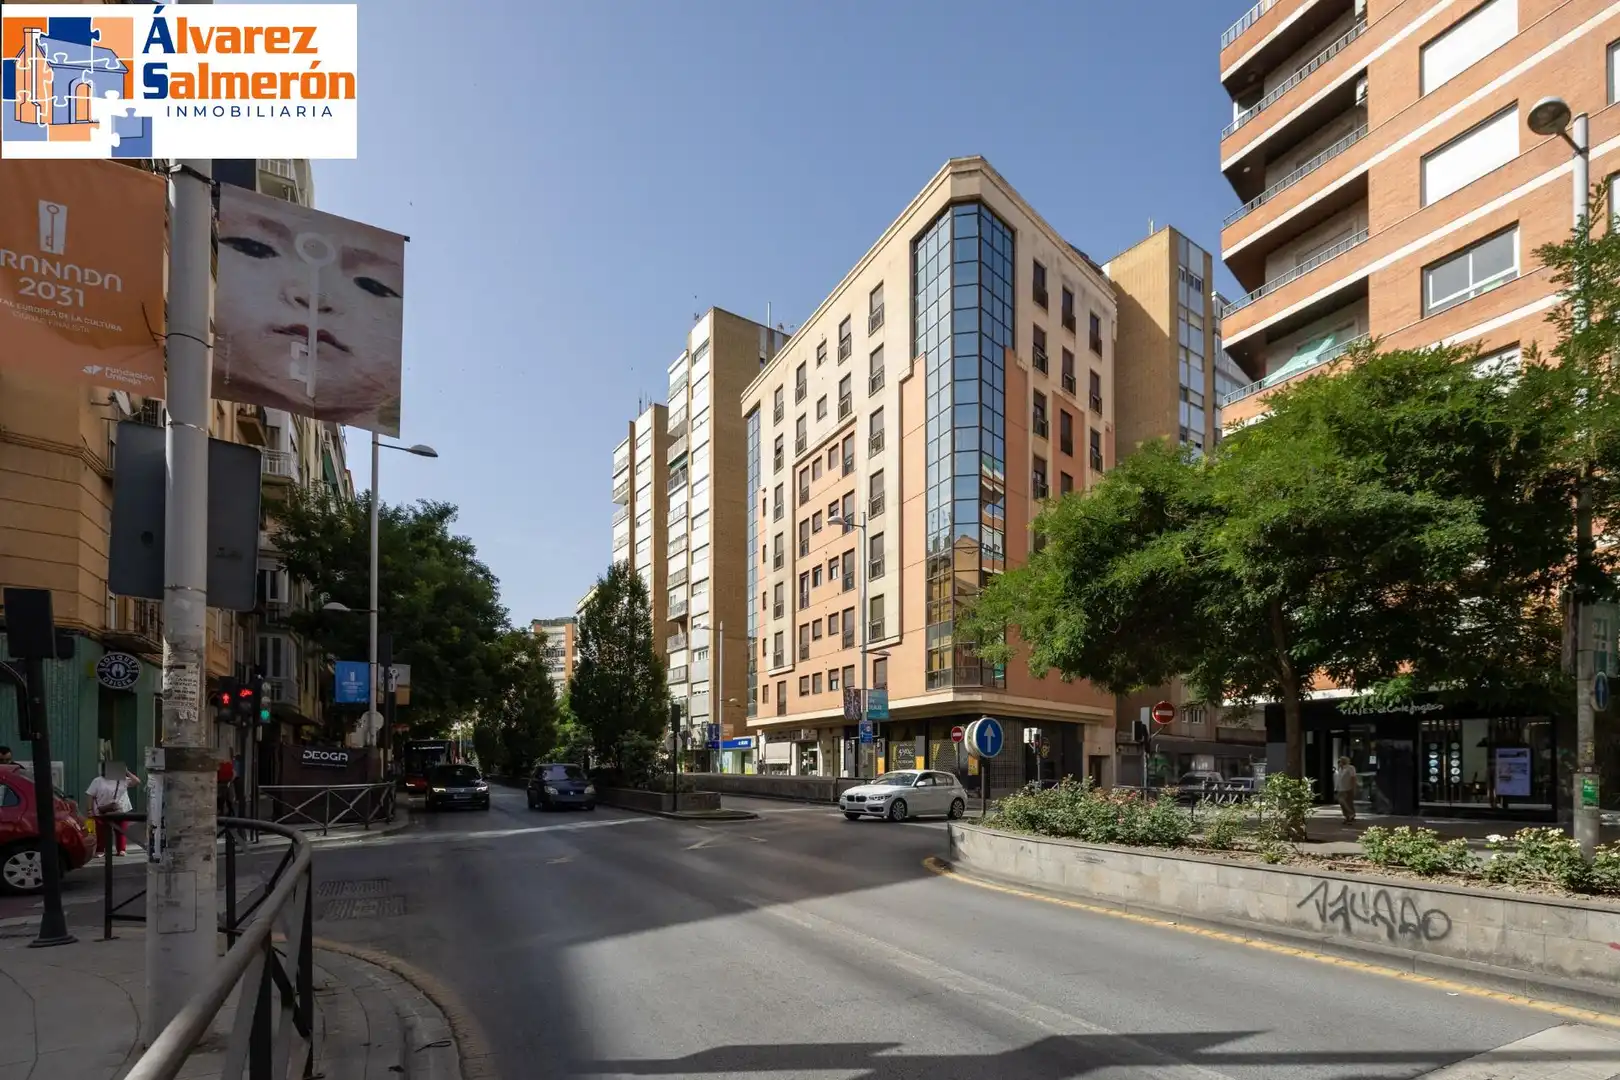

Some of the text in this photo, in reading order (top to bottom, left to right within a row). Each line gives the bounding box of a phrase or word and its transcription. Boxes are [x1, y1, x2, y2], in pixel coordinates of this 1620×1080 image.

[0, 249, 122, 292] RANADA
[18, 277, 84, 308] 2031
[16, 303, 56, 317] EUROPEA
[58, 311, 68, 320] DE
[71, 314, 83, 323] LA
[84, 317, 122, 332] CULTURA
[105, 366, 155, 382] Fundación
